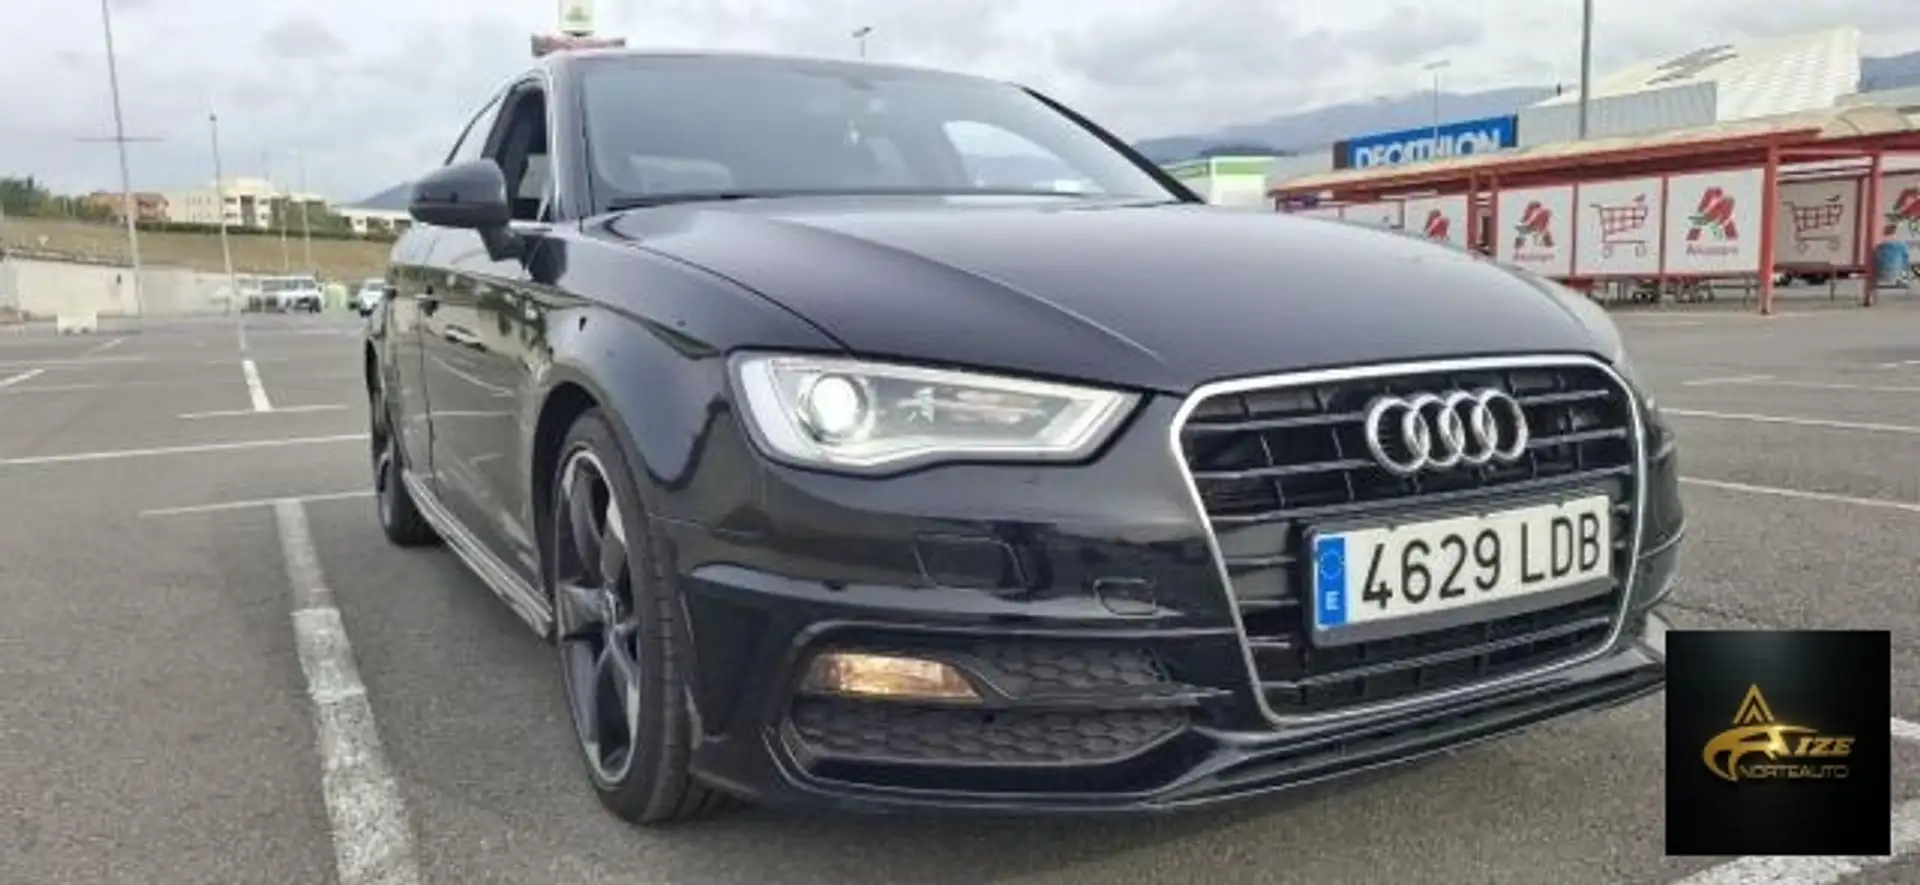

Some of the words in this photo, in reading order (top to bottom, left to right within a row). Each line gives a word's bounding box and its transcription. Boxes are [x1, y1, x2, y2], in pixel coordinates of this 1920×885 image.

[1355, 127, 1501, 170] DECATHLON
[1361, 528, 1500, 610] 4629
[1521, 512, 1600, 583] LDB
[1325, 591, 1340, 610] E
